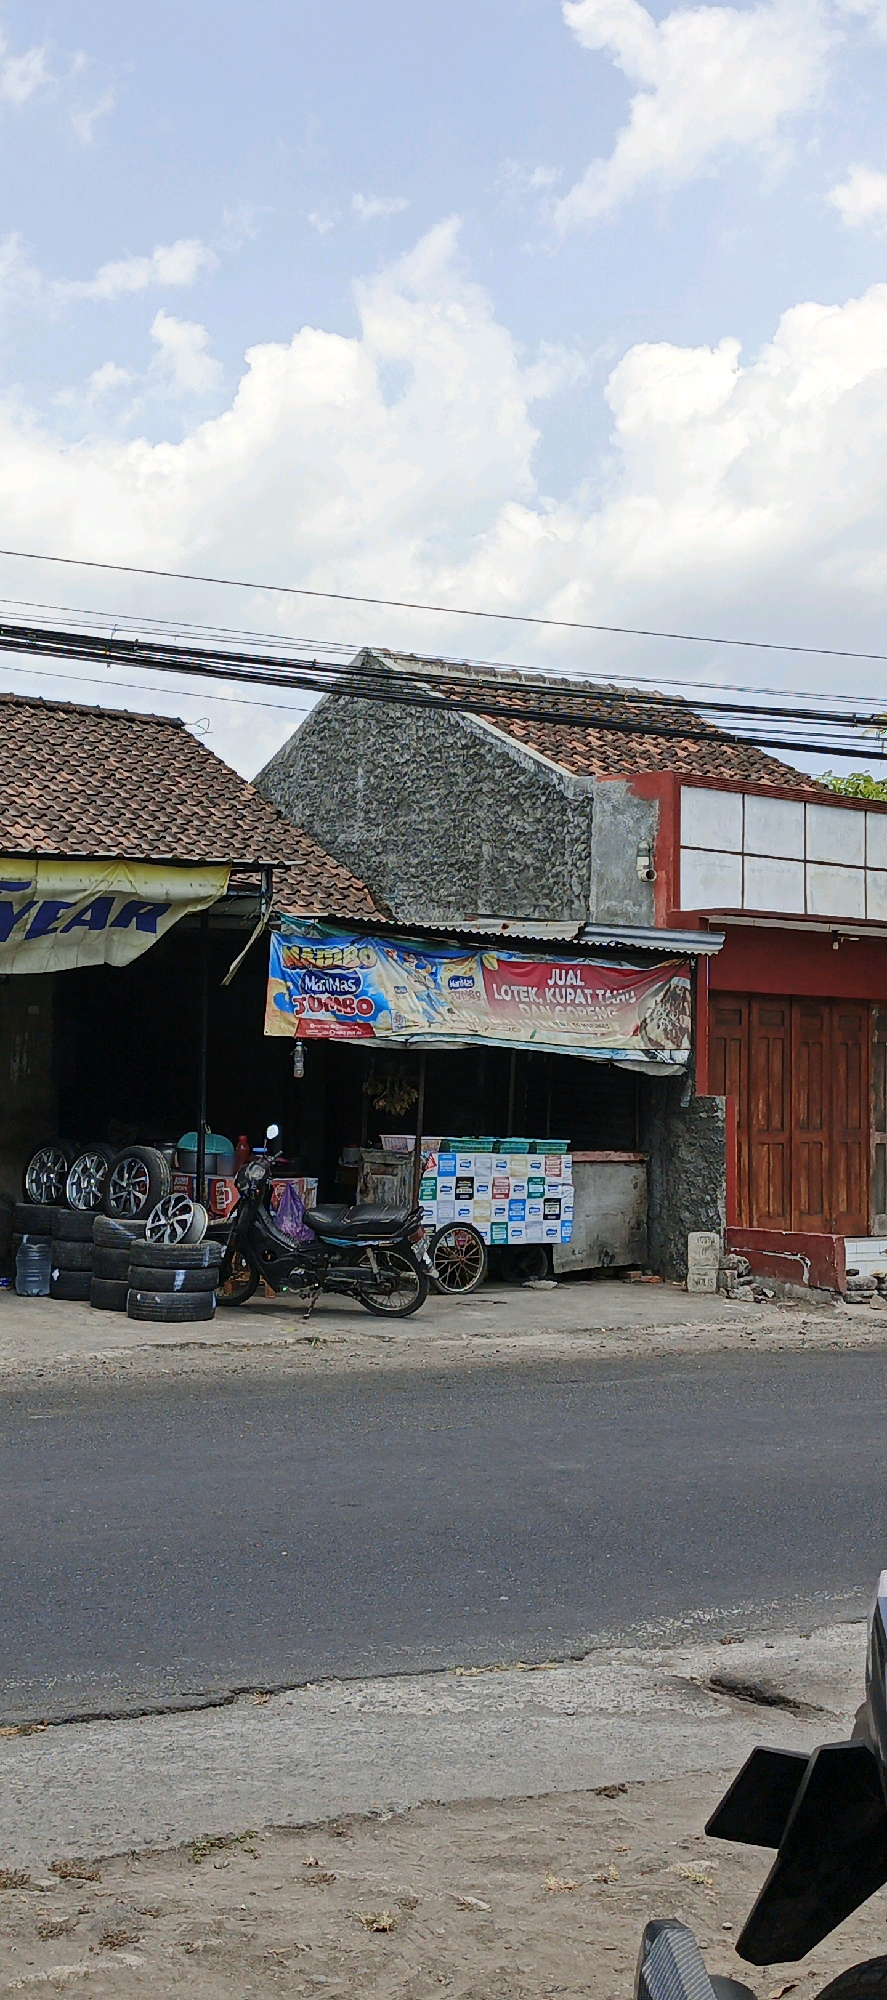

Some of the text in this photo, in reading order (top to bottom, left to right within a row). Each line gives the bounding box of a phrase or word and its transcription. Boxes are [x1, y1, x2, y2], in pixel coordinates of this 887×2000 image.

[547, 968, 585, 986] JUAL
[493, 984, 543, 1003] LOTEK,
[545, 987, 592, 1004] KUPAT
[293, 996, 374, 1015] JUMBO
